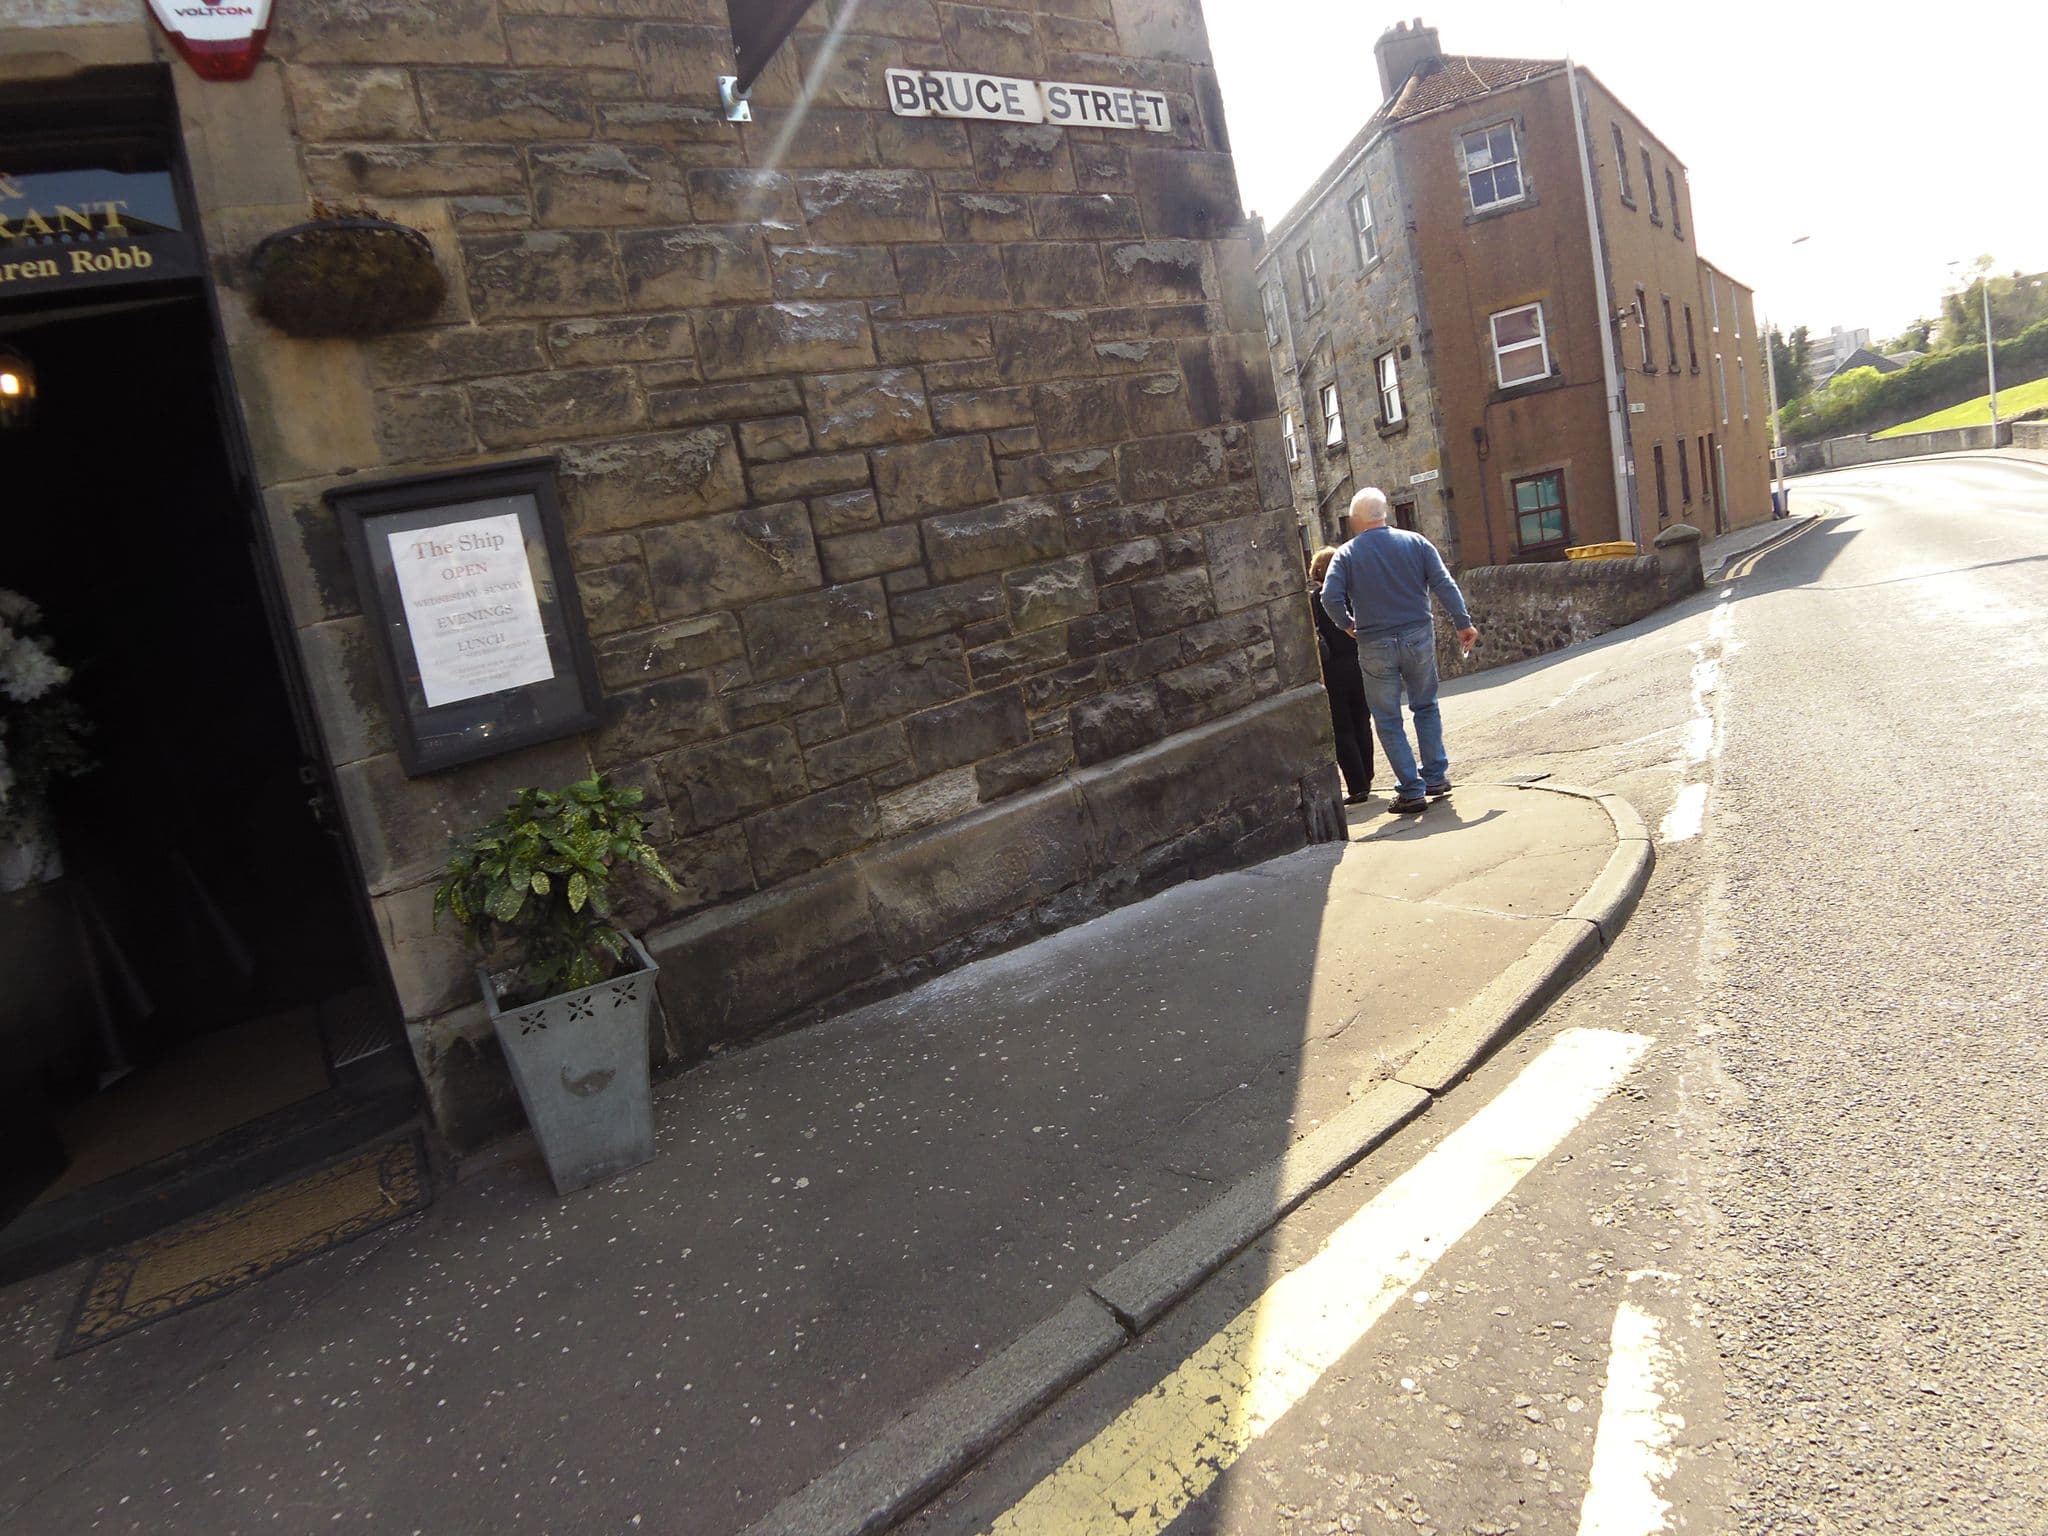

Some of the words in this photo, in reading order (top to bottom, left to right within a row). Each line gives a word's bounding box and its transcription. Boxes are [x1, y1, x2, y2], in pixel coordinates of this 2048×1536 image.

[174, 7, 253, 17] VOLTCOM
[891, 74, 1025, 116] BRUCE
[1047, 86, 1164, 126] STREET
[67, 245, 153, 274] Robb
[410, 541, 454, 560] The
[458, 532, 505, 552] Ship
[440, 562, 489, 582] OPEN
[437, 604, 514, 630] EVENINGS
[457, 632, 506, 653] LUNCH
